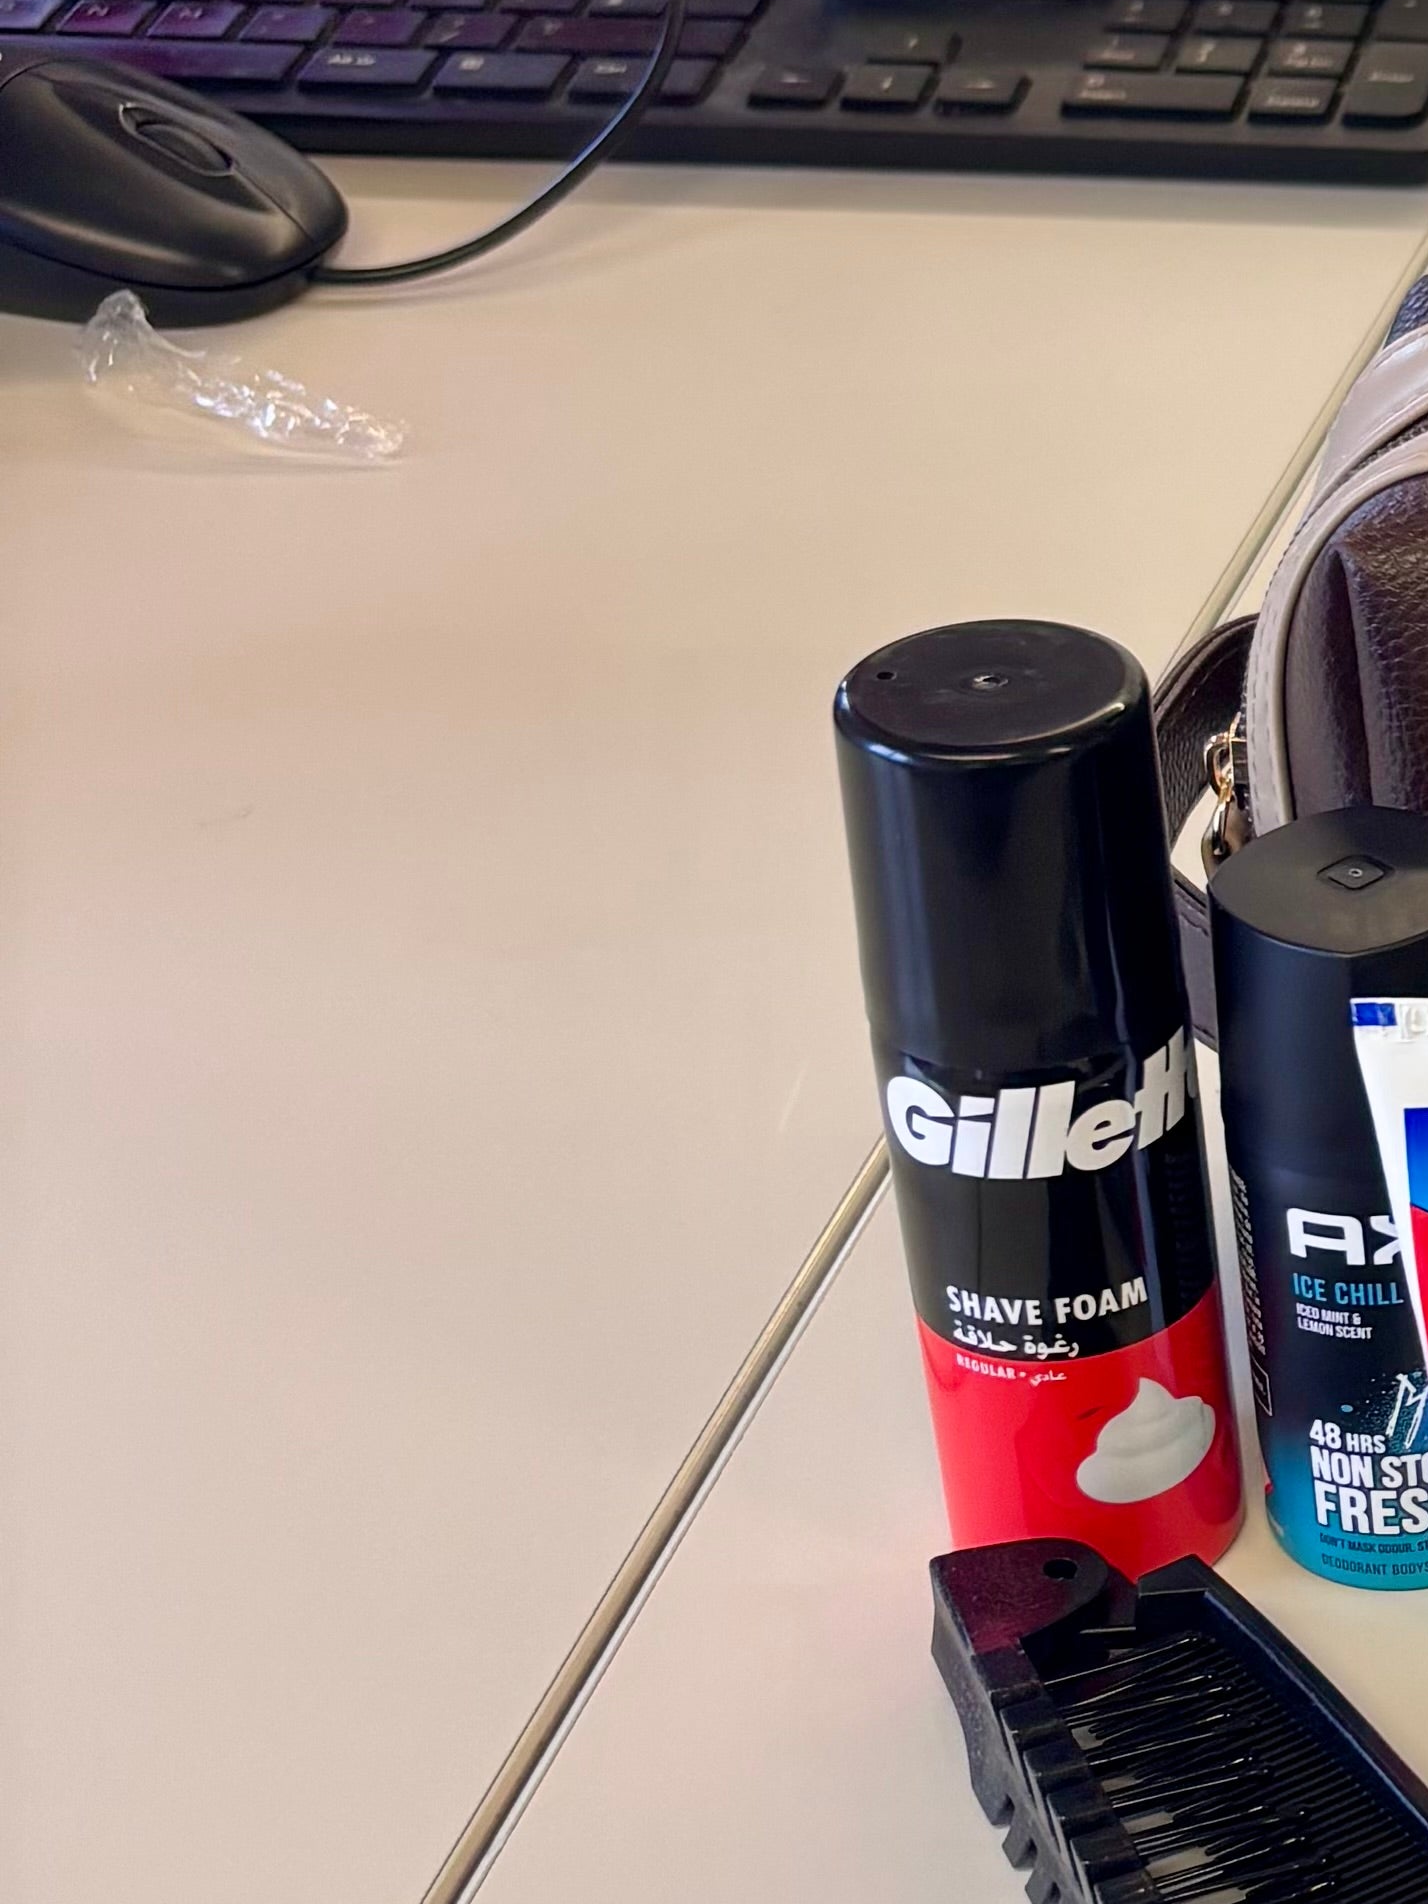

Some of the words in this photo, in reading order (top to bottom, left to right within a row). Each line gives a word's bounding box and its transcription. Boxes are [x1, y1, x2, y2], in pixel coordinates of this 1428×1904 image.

[887, 1025, 1197, 1179] Gillett
[1286, 1208, 1403, 1266] AX
[945, 1284, 1043, 1325] SHAVE
[1056, 1276, 1148, 1324] FOAM
[1293, 1273, 1327, 1303] ICE
[1336, 1282, 1404, 1306] CHILL
[1296, 1303, 1320, 1322] ICED
[1322, 1308, 1350, 1324] MINT
[1297, 1317, 1334, 1336] LEMON
[1335, 1325, 1373, 1340] SCENT
[953, 1319, 1017, 1353] حلاقة
[1023, 1333, 1079, 1360] رغوة
[956, 1353, 1016, 1380] REGULAR
[1030, 1369, 1067, 1387] عادي
[1309, 1419, 1342, 1449] 48
[1345, 1433, 1387, 1454] HRS
[1310, 1446, 1375, 1489] NON
[1321, 1554, 1388, 1577] DEODORANT
